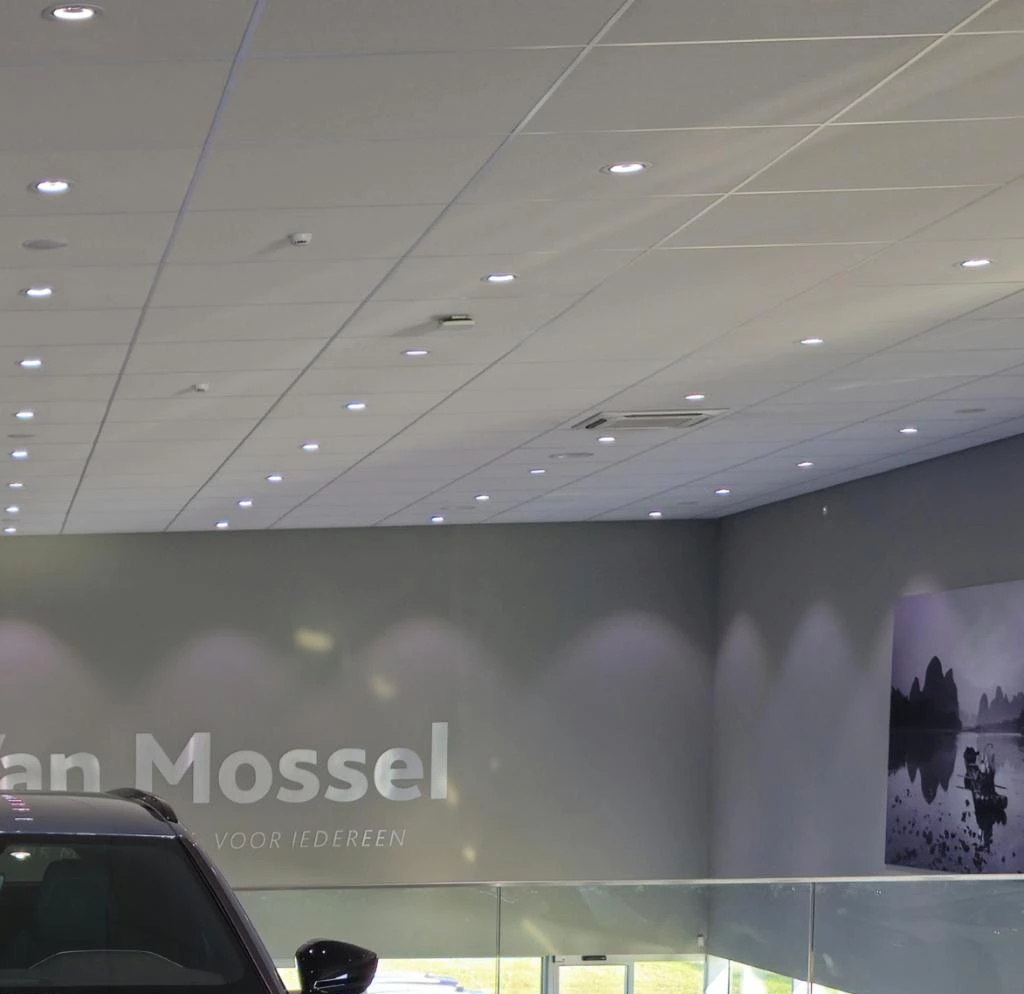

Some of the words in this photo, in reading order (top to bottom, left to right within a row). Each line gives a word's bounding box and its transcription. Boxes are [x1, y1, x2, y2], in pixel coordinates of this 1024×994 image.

[134, 721, 449, 804] Mossel
[214, 831, 282, 850] VOOR
[291, 828, 406, 849] IEDEREEN
